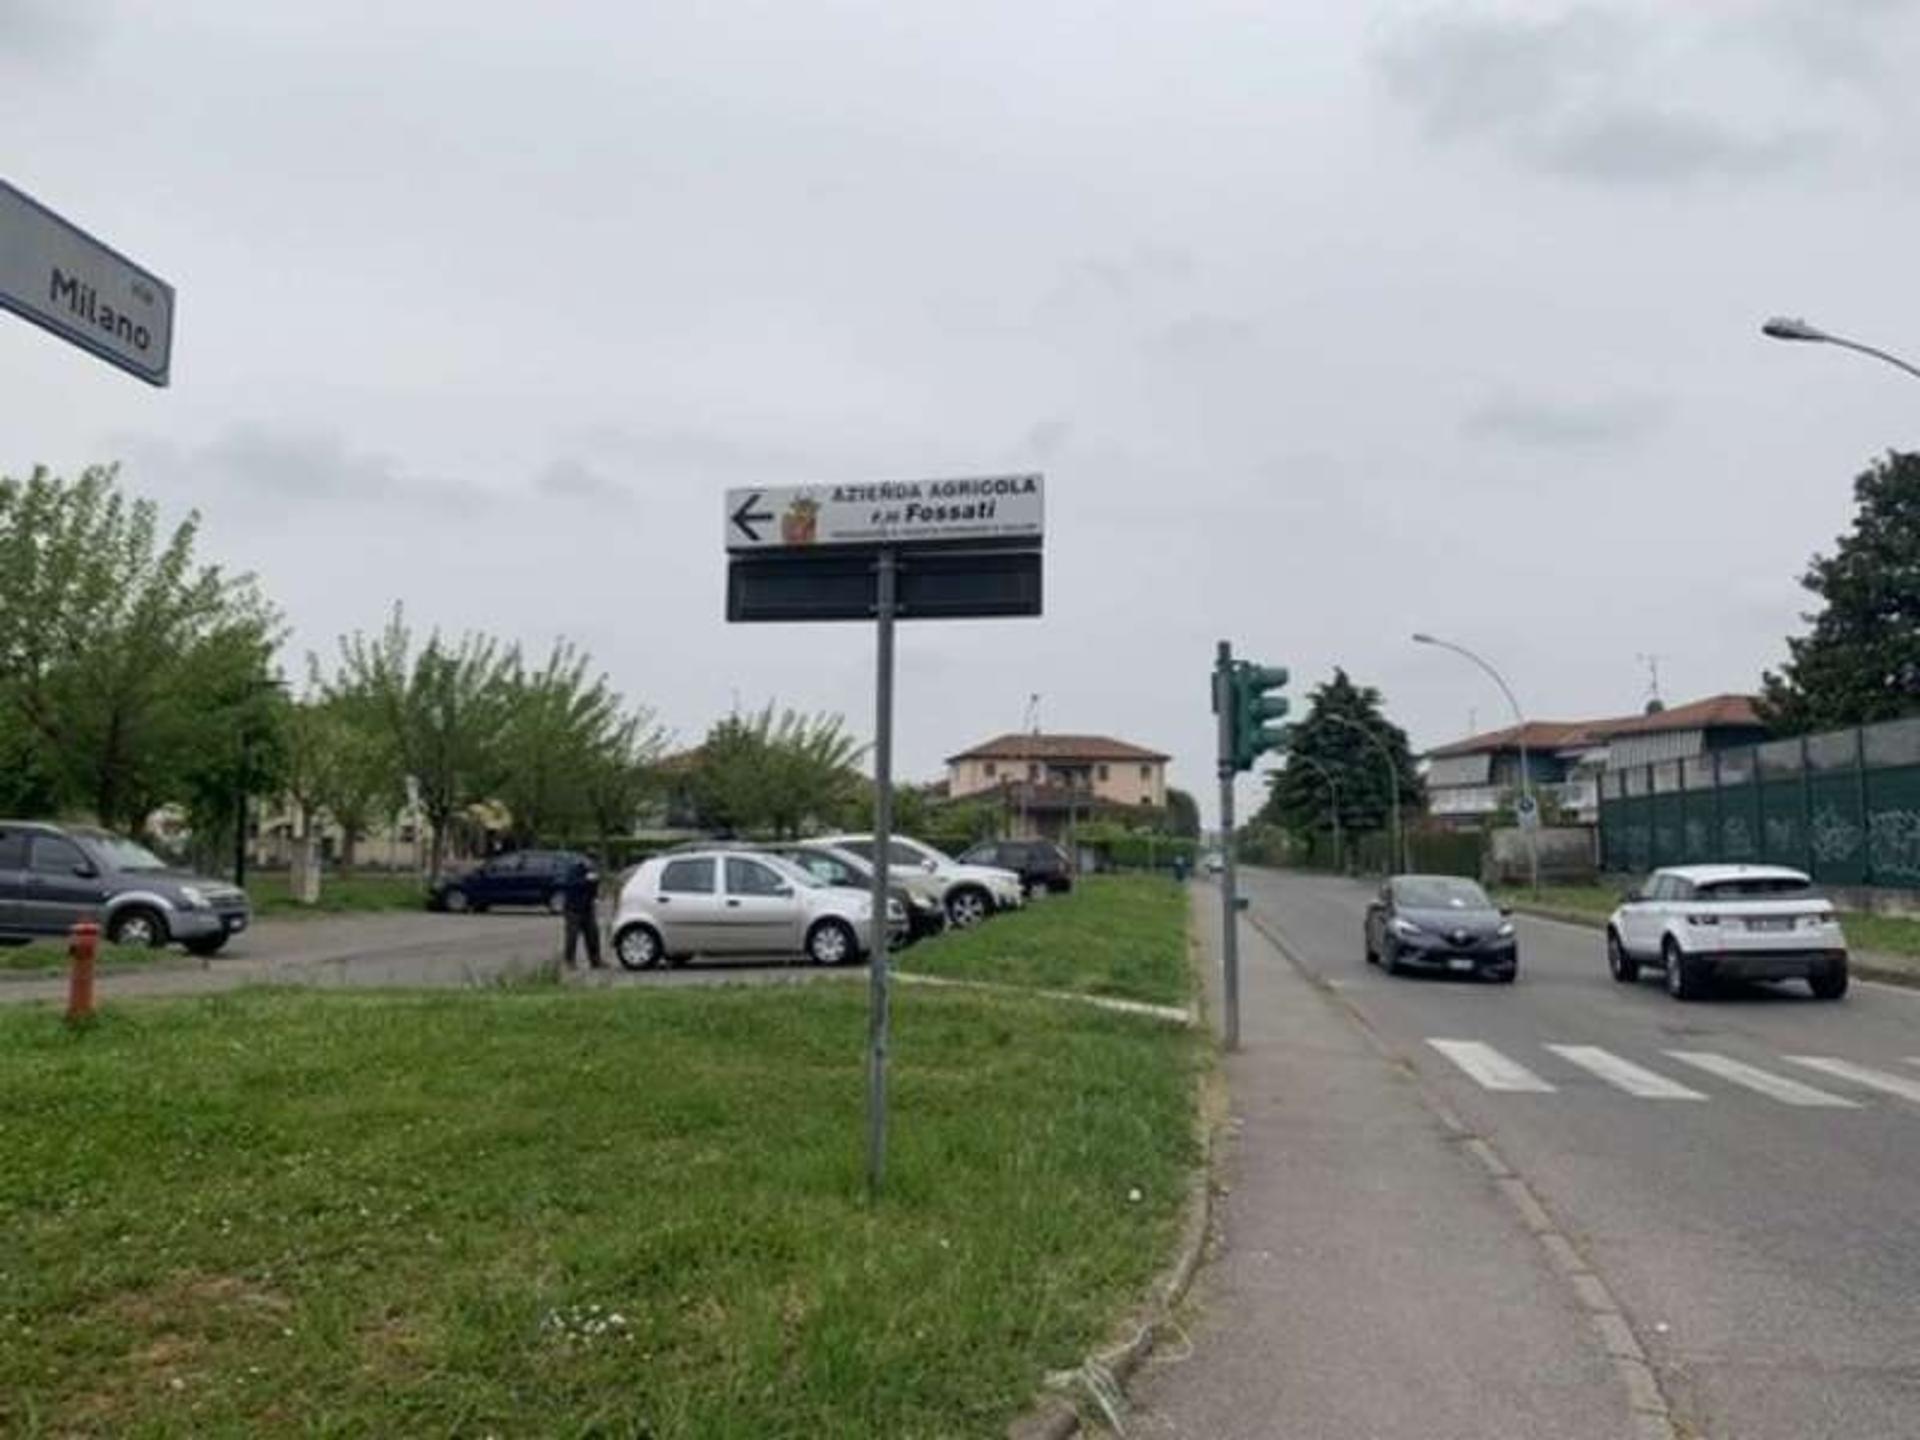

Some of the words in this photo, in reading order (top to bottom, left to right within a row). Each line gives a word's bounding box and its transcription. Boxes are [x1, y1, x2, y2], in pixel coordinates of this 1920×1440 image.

[50, 269, 151, 350] Milano
[833, 483, 921, 503] AZIENDA
[931, 479, 1037, 497] AGRICOLA
[907, 501, 996, 522] Fossati
